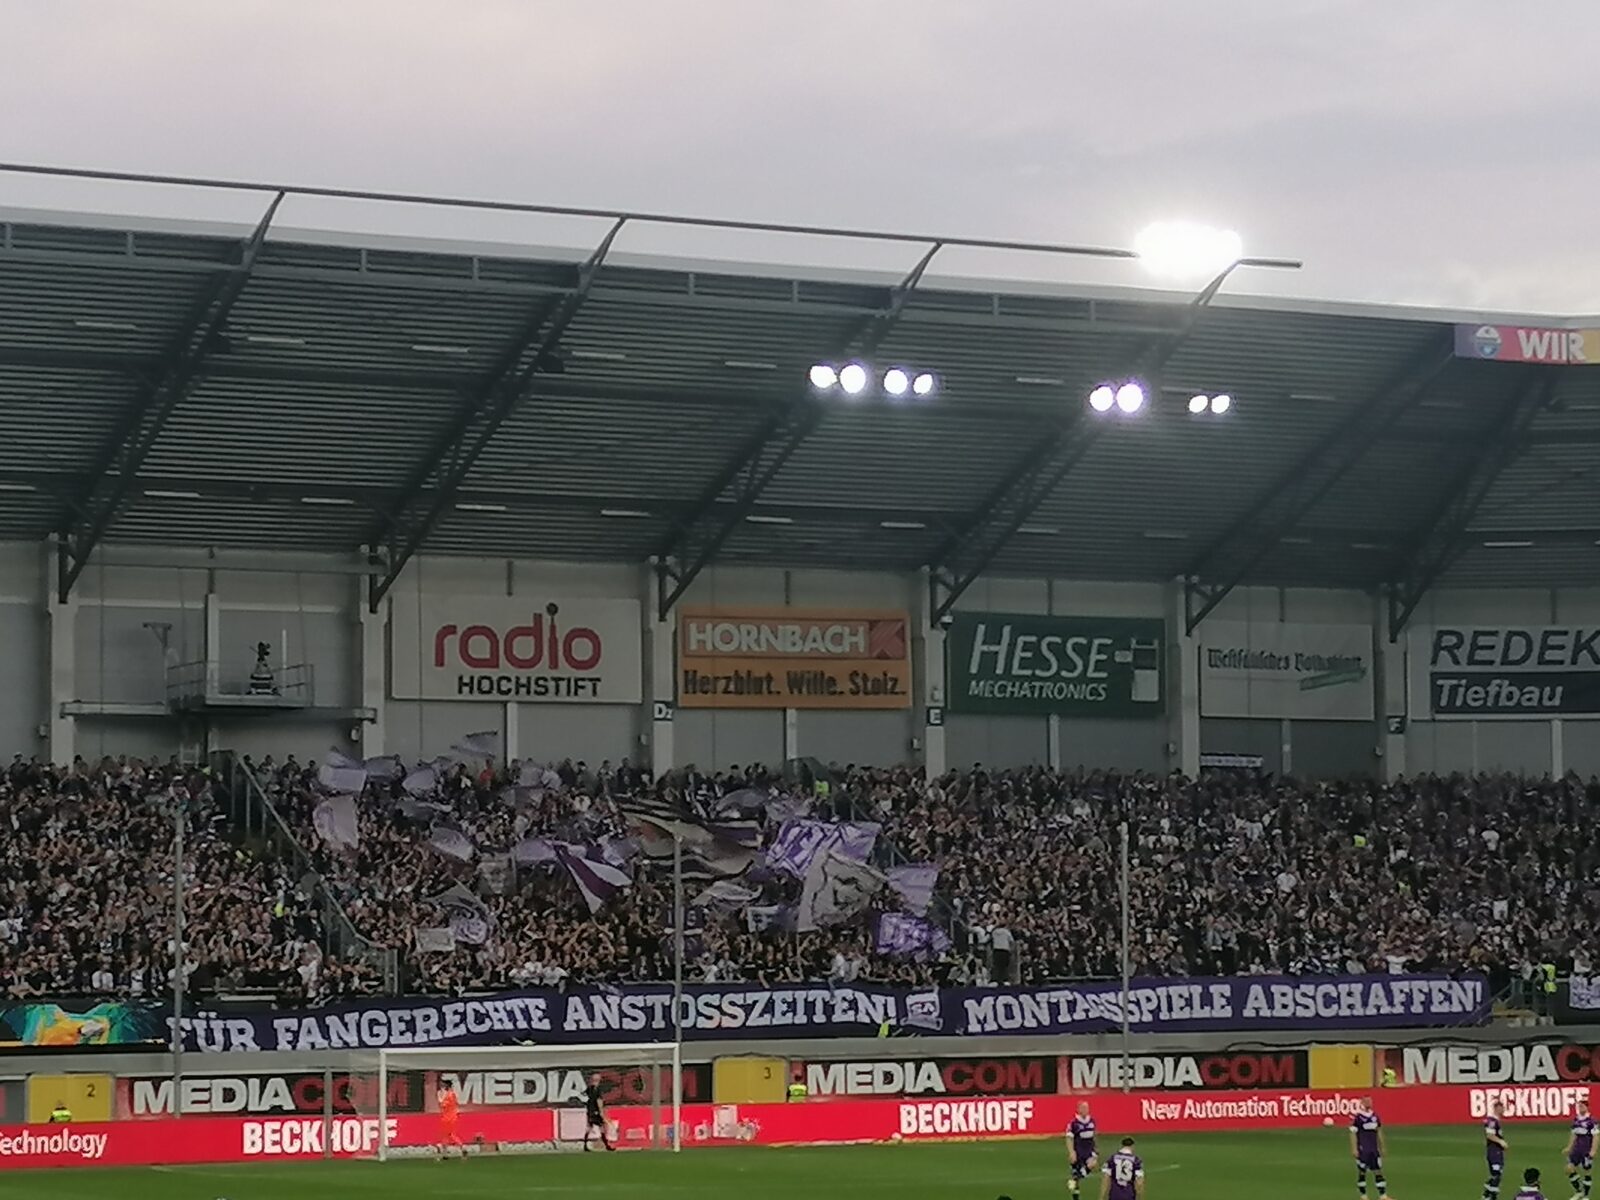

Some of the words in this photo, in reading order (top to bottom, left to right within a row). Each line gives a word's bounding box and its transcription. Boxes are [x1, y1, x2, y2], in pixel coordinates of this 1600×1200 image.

[434, 603, 602, 670] radio
[689, 622, 865, 653] HORNBACH
[968, 624, 1114, 678] HESSE
[1431, 629, 1600, 666] REDEK
[457, 675, 602, 697] HOCHSTIFT
[683, 670, 781, 695] Herzblut.
[786, 670, 845, 695] Wille.
[848, 670, 907, 695] Stolz.
[968, 680, 1108, 702] MECHATRONICS
[1436, 679, 1564, 708] Tiefbau
[929, 709, 942, 724] E
[1243, 983, 1482, 1017] ABSCHAFFEN!
[165, 1011, 260, 1053] FÜR
[273, 998, 552, 1051] FANGERECHTE
[563, 989, 897, 1031] ANSTOSSZEITEN!
[763, 1066, 772, 1080] 3
[807, 1060, 1044, 1095] MEDIACOM
[1072, 1056, 1296, 1088] MEDIACOM
[86, 1083, 96, 1098] 2
[900, 1100, 1033, 1134] BECKHOFF
[1141, 1098, 1181, 1119] New
[1184, 1096, 1278, 1118] Automation
[1280, 1093, 1362, 1117] Technolog
[0, 1128, 108, 1158] echnology
[243, 1119, 398, 1154] BECKHOFF
[1114, 1158, 1133, 1182] 13
